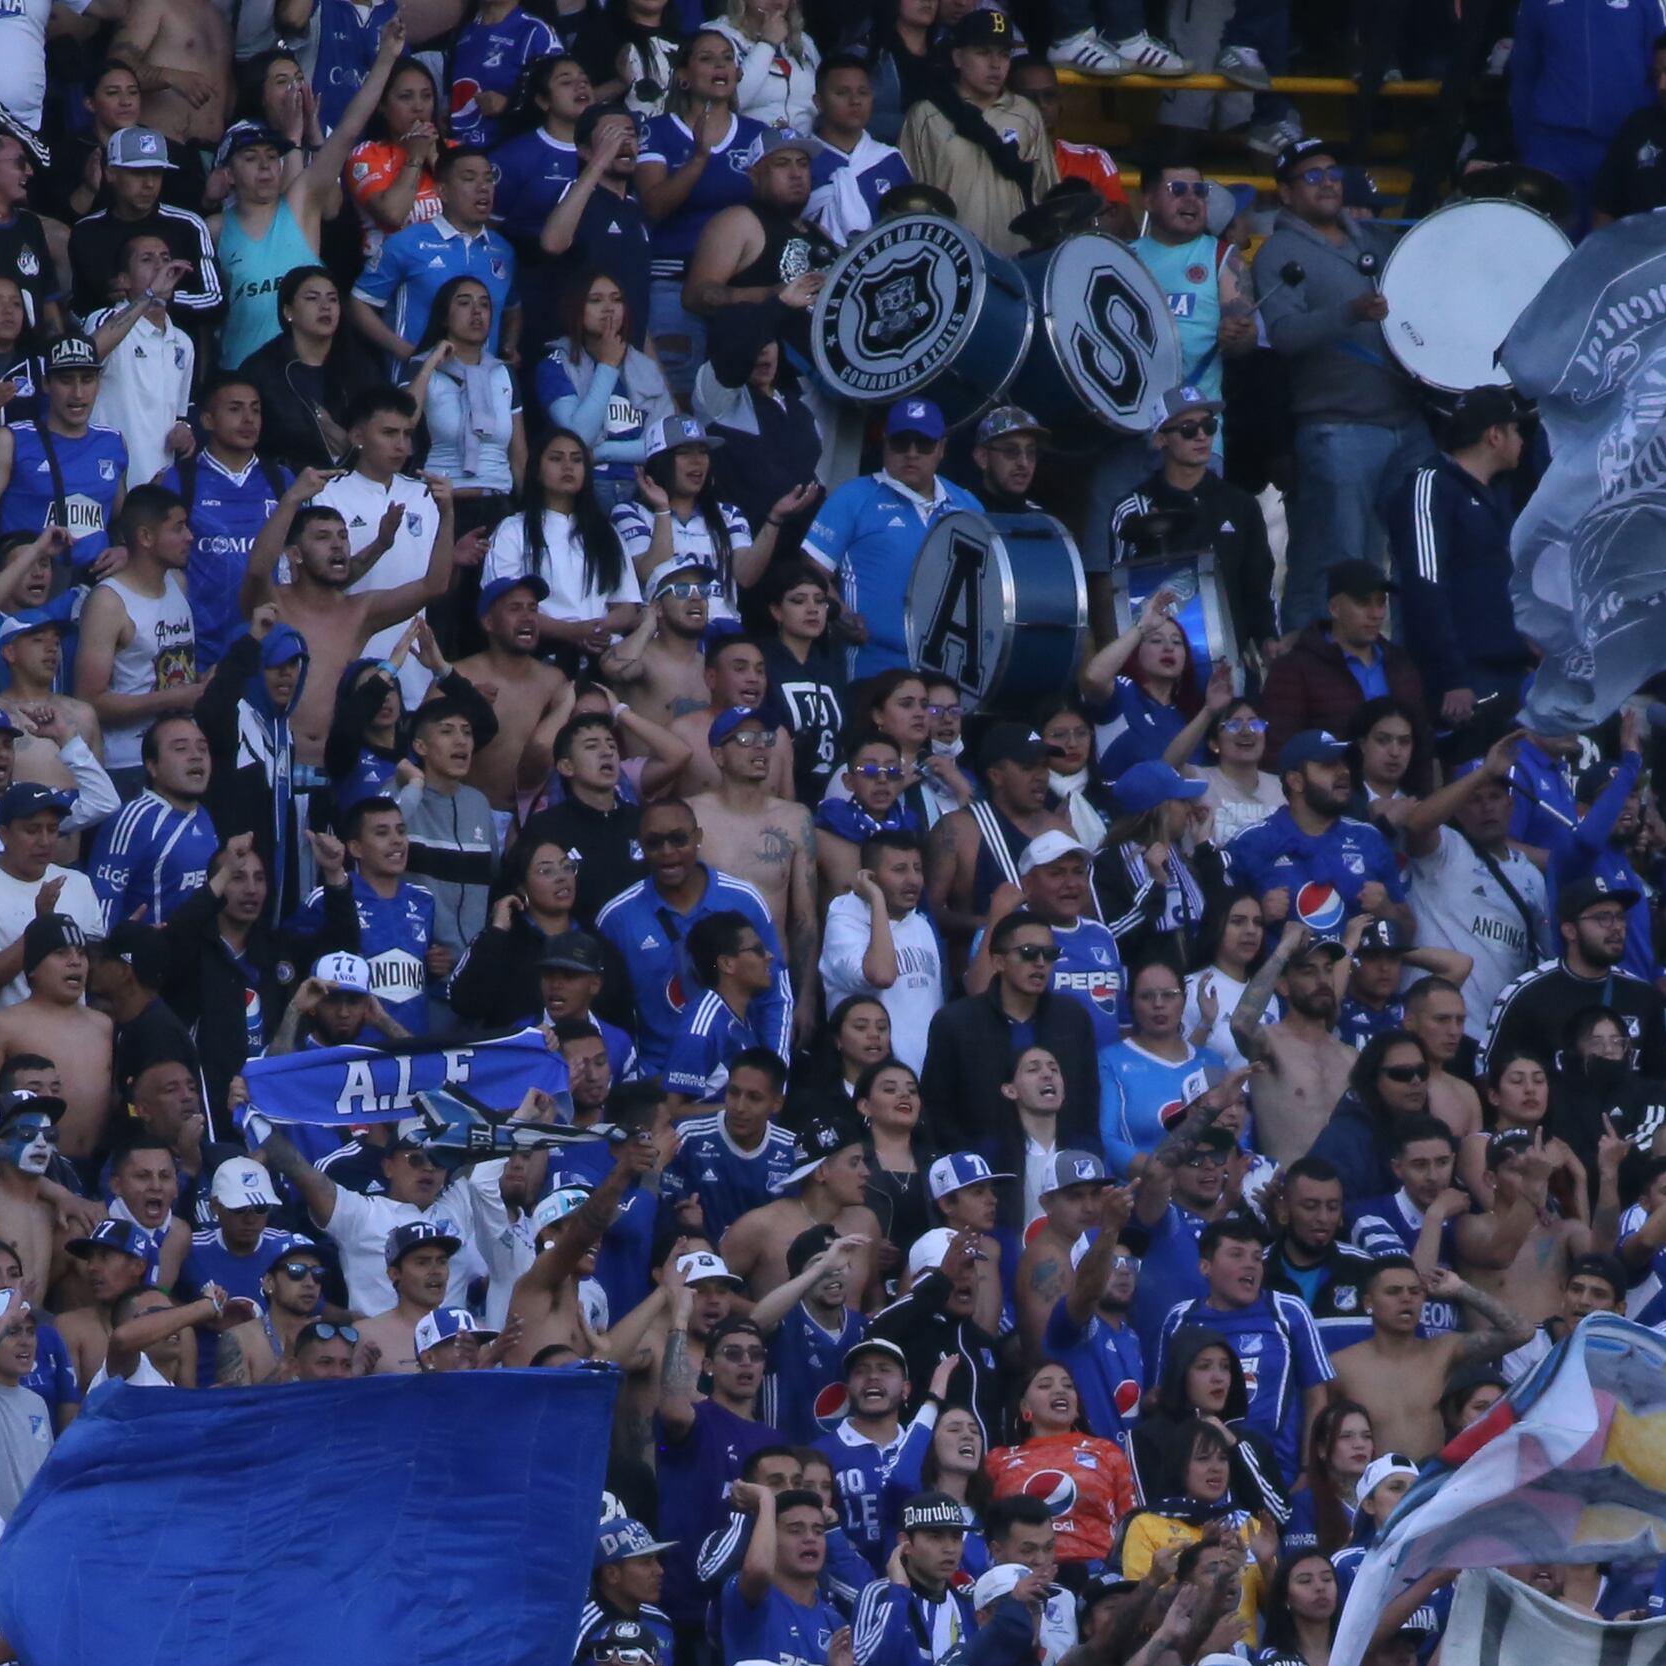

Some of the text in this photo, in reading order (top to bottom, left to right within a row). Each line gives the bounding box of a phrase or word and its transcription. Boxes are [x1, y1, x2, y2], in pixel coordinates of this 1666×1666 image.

[989, 12, 1006, 34] B
[840, 222, 968, 287] INSTRUMENTAL
[839, 311, 965, 390] COMANDOS AZULES
[1071, 264, 1159, 416] S
[609, 404, 643, 429] DINA
[43, 502, 103, 529] ADINA
[917, 528, 989, 700] A
[1471, 914, 1527, 950] ANDINA
[332, 956, 357, 974] 77
[367, 959, 426, 991] ANDINA
[1053, 971, 1121, 992] PEPS
[1422, 1302, 1459, 1329] EON
